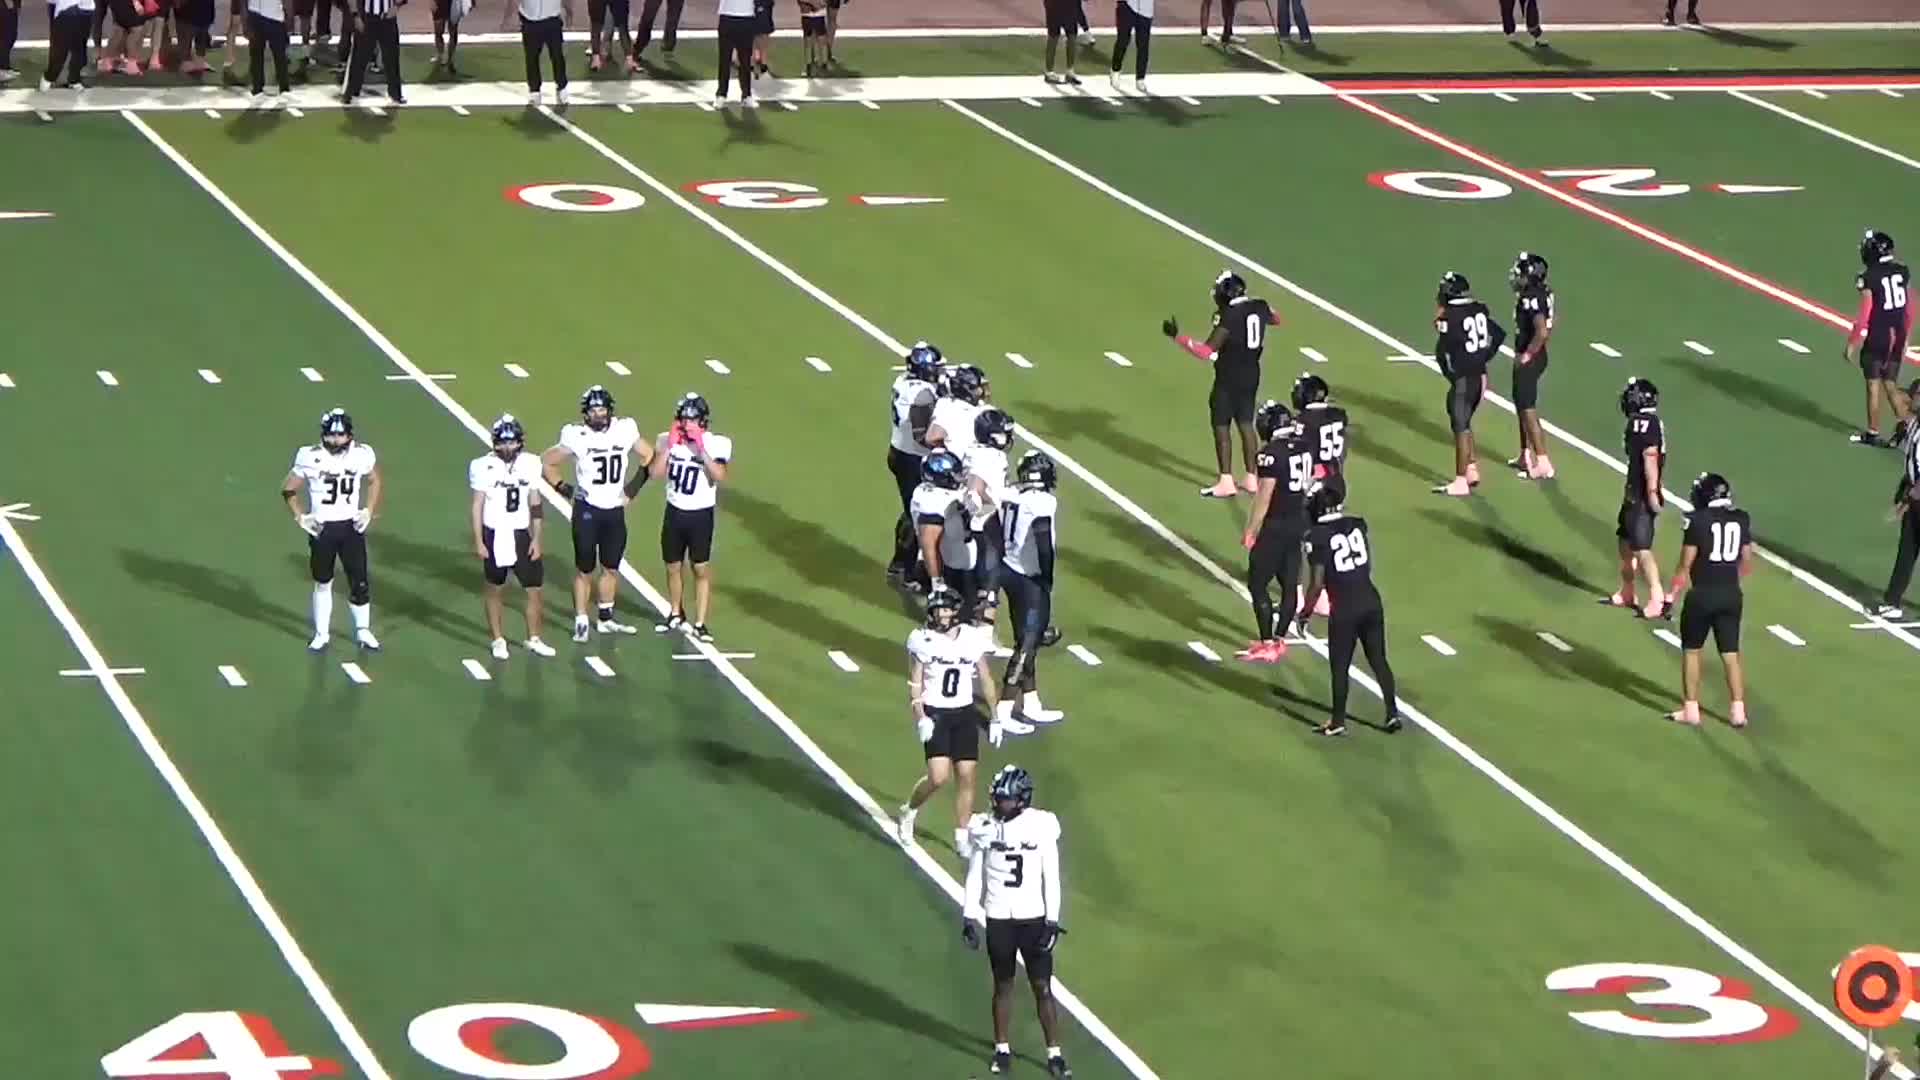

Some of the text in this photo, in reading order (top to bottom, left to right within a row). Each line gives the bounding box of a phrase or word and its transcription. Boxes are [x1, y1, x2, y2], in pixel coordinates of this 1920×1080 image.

[1881, 273, 1906, 310] 16
[1246, 313, 1260, 349] 0
[1463, 312, 1488, 353] 39
[1319, 421, 1344, 461] 55
[1633, 419, 1650, 432] 17
[592, 454, 622, 485] 30
[668, 463, 700, 495] 40
[1289, 451, 1312, 491] 50
[321, 477, 354, 505] 34
[506, 487, 520, 512] 8
[1330, 527, 1368, 572] 29
[1709, 521, 1741, 562] 10
[941, 668, 960, 698] 0
[1003, 854, 1023, 888] 3
